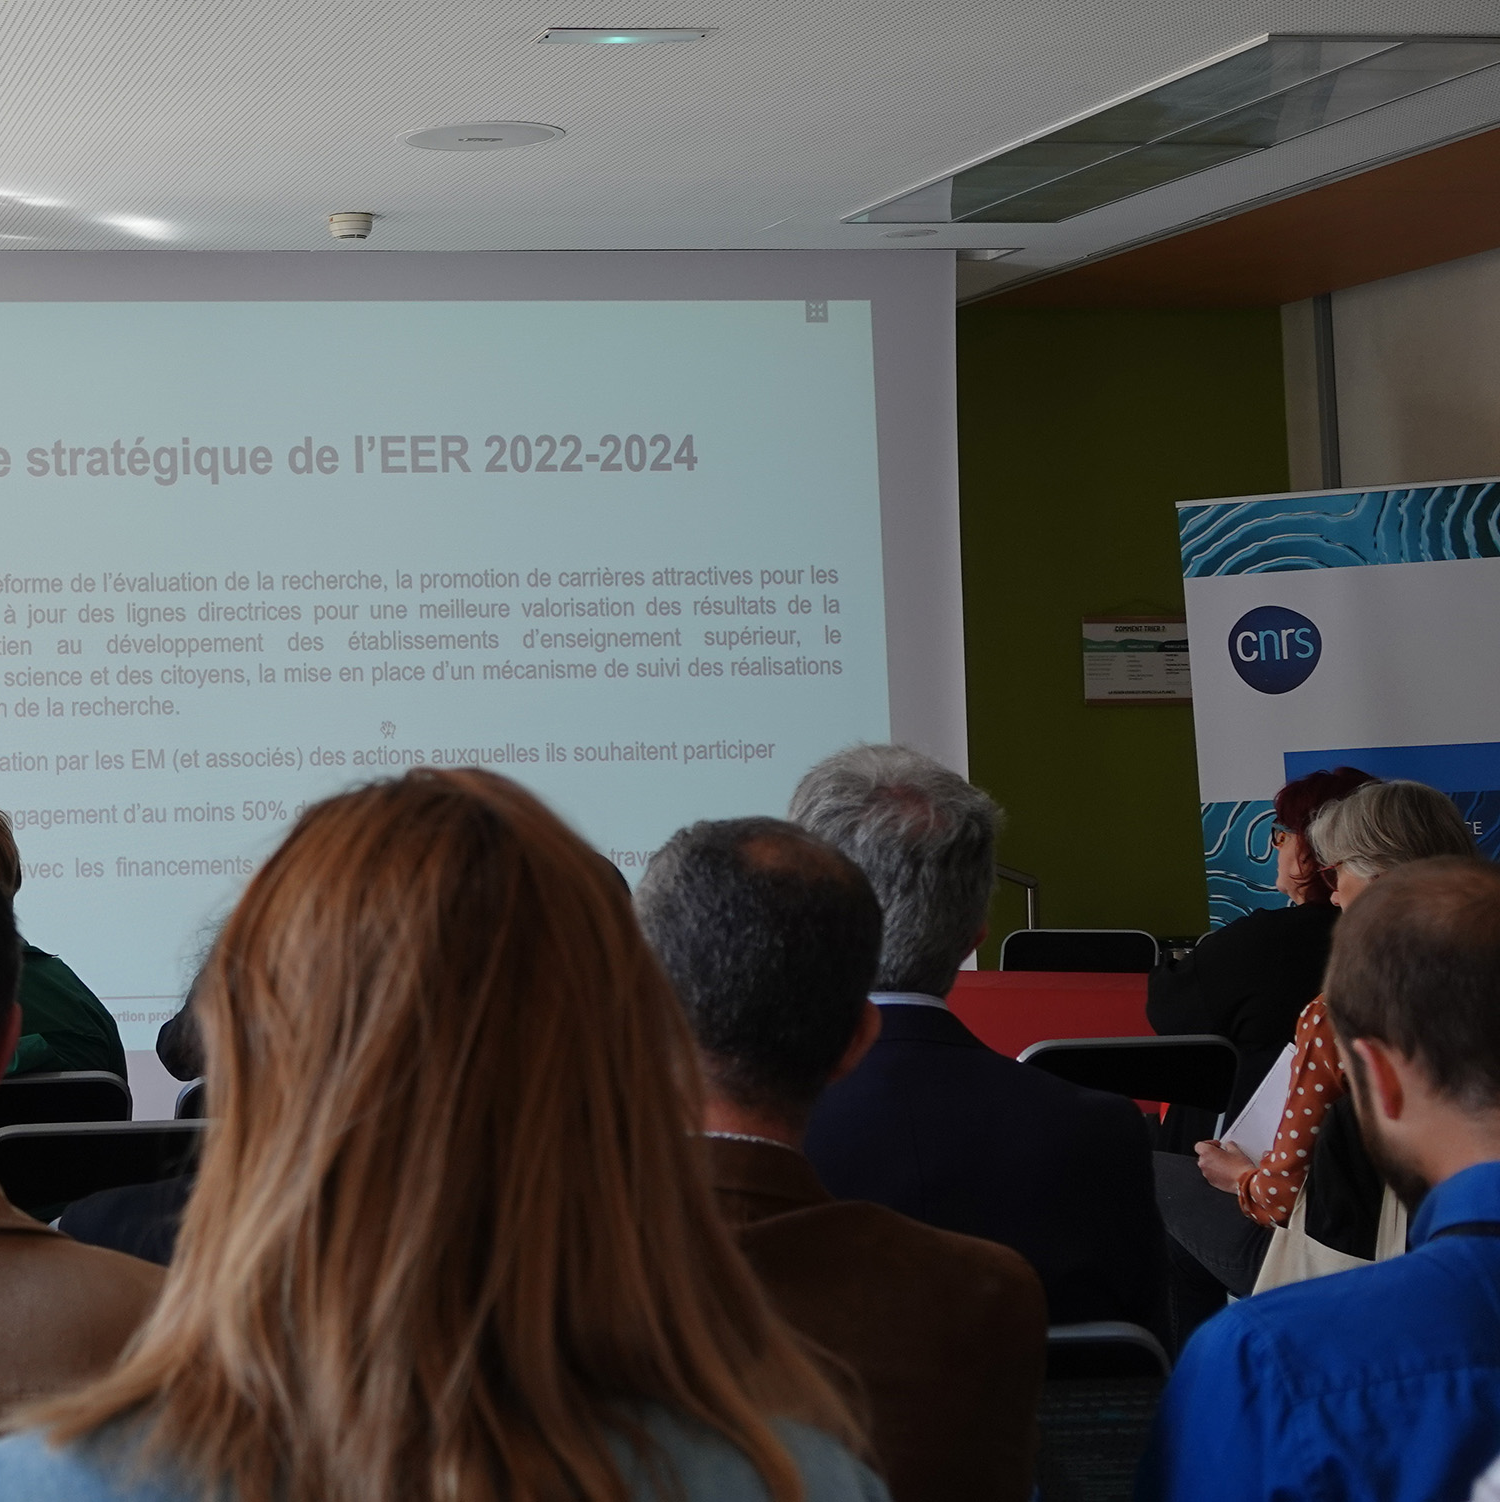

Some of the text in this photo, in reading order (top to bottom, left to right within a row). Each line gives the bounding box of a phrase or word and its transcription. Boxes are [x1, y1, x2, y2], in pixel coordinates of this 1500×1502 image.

[27, 436, 273, 487] stratégique
[288, 436, 339, 475] de
[355, 434, 471, 474] l'EER
[485, 433, 698, 474] 2022-2024
[70, 573, 96, 594] de
[103, 571, 217, 593] l'évaluation
[225, 571, 250, 592] de
[257, 570, 274, 591] la
[282, 569, 388, 592] recherche,
[396, 569, 413, 590] la
[420, 567, 520, 593] promotion
[526, 567, 551, 588] de
[558, 566, 645, 588] carrières
[652, 566, 753, 587] attractives
[760, 569, 805, 590] pour
[810, 564, 839, 585] les
[4, 604, 16, 625] à
[27, 603, 67, 629] jour
[78, 603, 115, 624] des
[127, 602, 186, 628] lignes
[198, 600, 302, 622] directrices
[314, 604, 359, 626] pour
[370, 604, 407, 620] une
[419, 598, 510, 620] meilleure
[521, 596, 635, 618] valorisation
[645, 595, 682, 617] des
[693, 595, 777, 617] résultats
[787, 594, 812, 616] de
[823, 594, 840, 614] la
[57, 638, 82, 655] au
[106, 633, 264, 658] développement
[287, 631, 324, 652] des
[348, 630, 499, 652] établissements
[522, 628, 682, 654] d'enseignement
[704, 625, 801, 651] supérieur,
[824, 624, 842, 645] le
[1236, 627, 1314, 662] cnrs
[4, 666, 82, 687] science
[90, 666, 109, 686] et
[116, 665, 153, 686] des
[161, 664, 250, 689] citoyens,
[259, 663, 276, 684] la
[284, 662, 332, 683] mise
[339, 666, 364, 683] en
[372, 661, 425, 686] place
[432, 659, 475, 682] d'un
[483, 659, 597, 681] mécanisme
[604, 657, 629, 679] de
[636, 657, 680, 679] suivi
[687, 656, 724, 678] des
[731, 656, 843, 677] réalisations
[14, 696, 40, 719] de
[47, 696, 64, 718] la
[72, 695, 180, 718] recherche.
[56, 754, 89, 775] par
[95, 750, 124, 771] les
[132, 748, 165, 770] EM
[173, 749, 200, 773] (et
[206, 747, 303, 771] associés)
[309, 745, 346, 766] des
[353, 745, 425, 765] actions
[431, 743, 540, 767] auxquelles
[546, 742, 567, 763] ils
[573, 740, 678, 762] souhaitent
[683, 739, 775, 765] participer
[124, 803, 167, 823] d'au
[174, 802, 235, 823] moins
[242, 800, 287, 821] 50%
[75, 855, 253, 878] les financements
